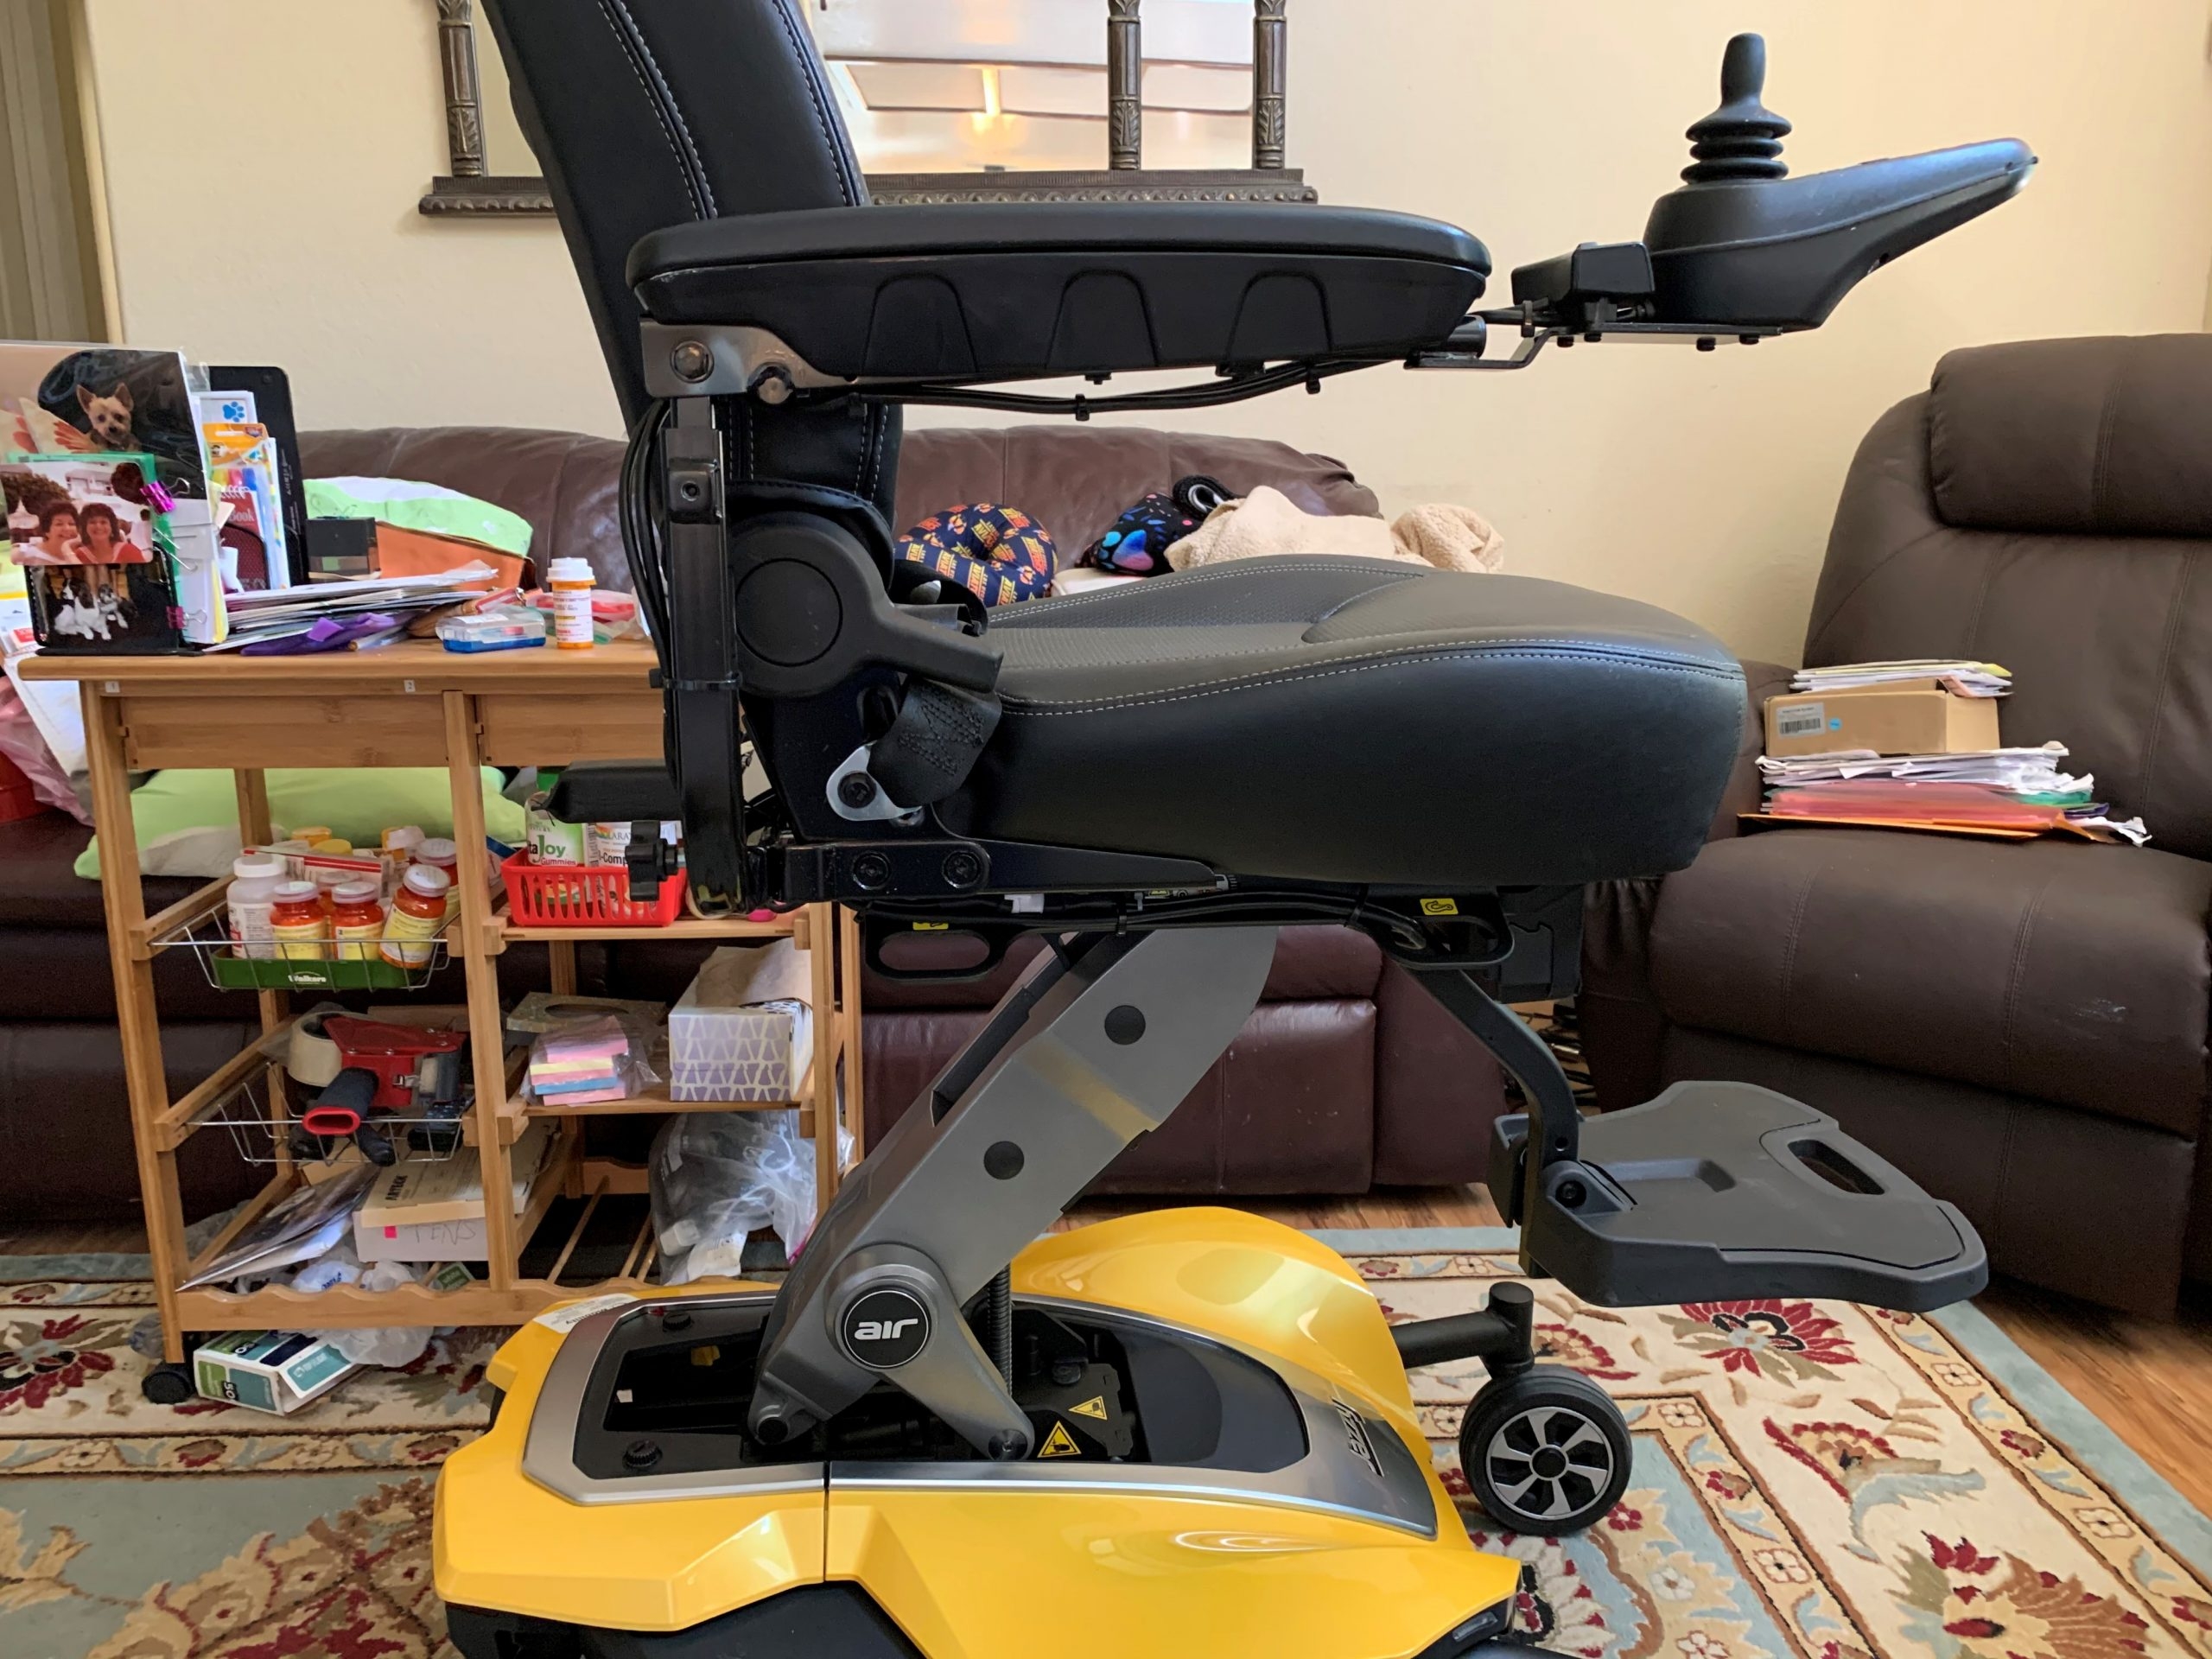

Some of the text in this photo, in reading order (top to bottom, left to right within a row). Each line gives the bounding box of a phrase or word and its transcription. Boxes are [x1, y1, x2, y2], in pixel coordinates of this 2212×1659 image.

[528, 835, 566, 863] taJoy
[854, 1318, 918, 1341] air
[223, 1382, 236, 1400] 50
[1332, 1396, 1384, 1478] Jazzy
